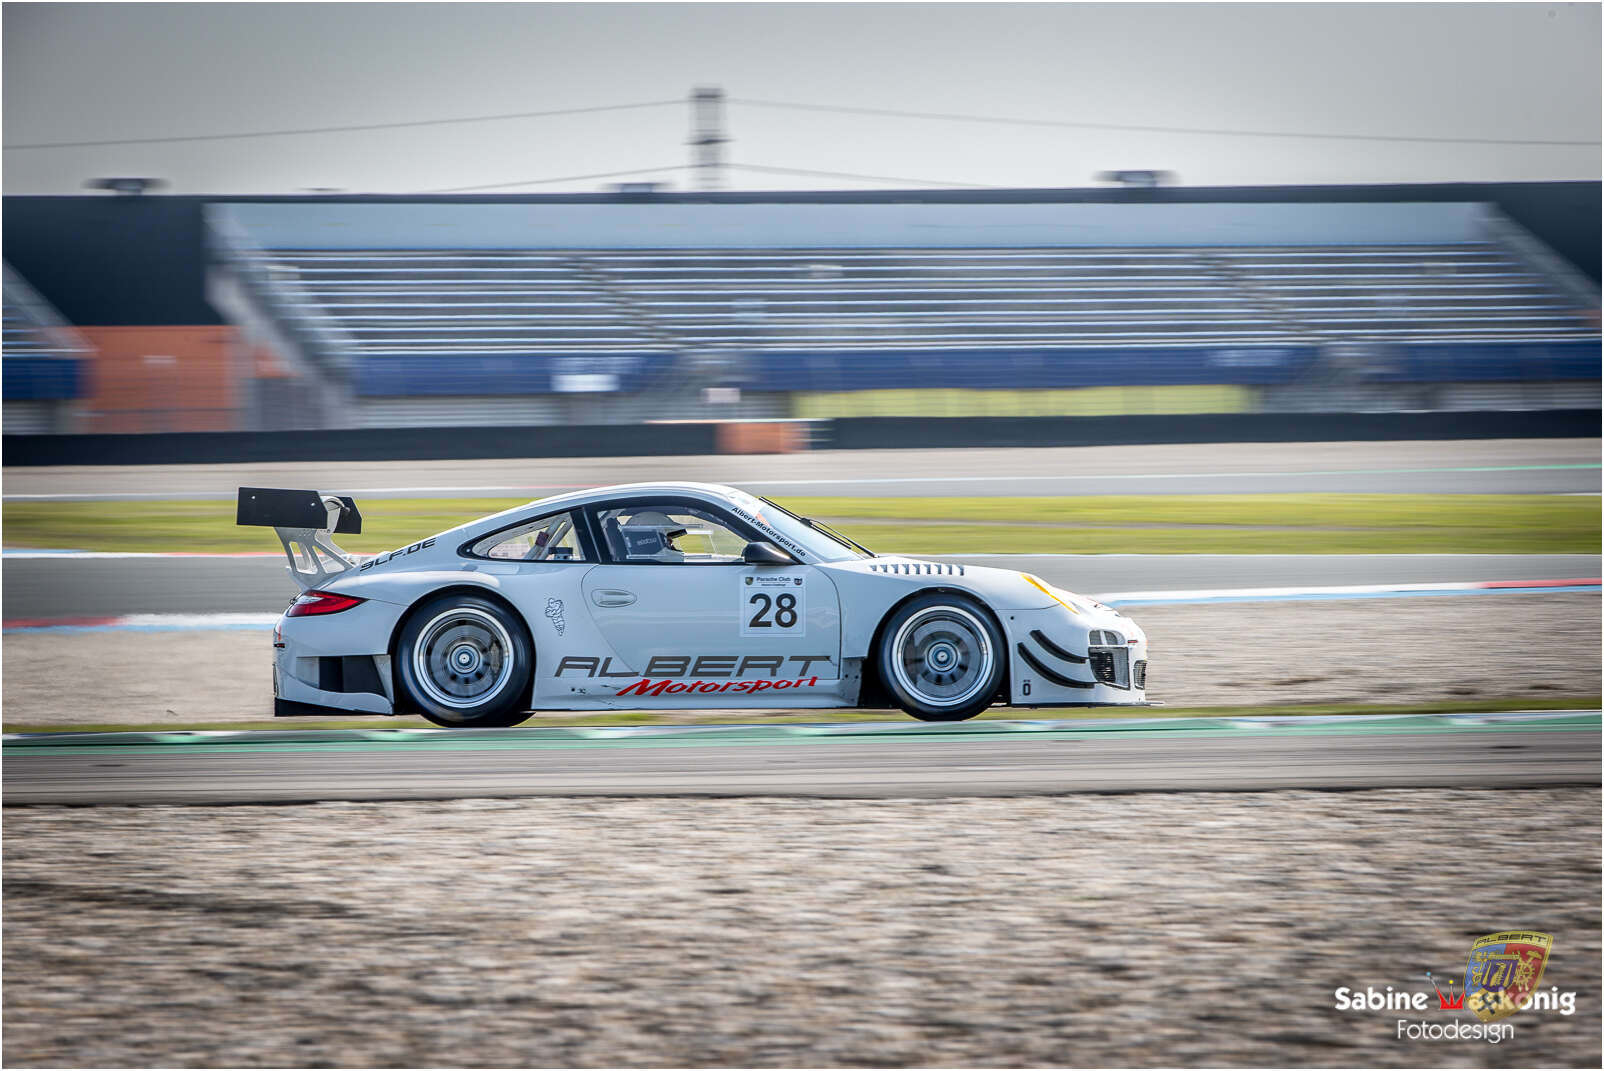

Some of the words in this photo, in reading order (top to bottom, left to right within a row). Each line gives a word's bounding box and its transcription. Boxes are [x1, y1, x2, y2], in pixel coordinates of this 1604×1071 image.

[732, 507, 806, 557] Albert-Motorsport.de
[749, 593, 797, 628] 28
[554, 656, 831, 678] ALBERT
[615, 676, 819, 697] Motorsport
